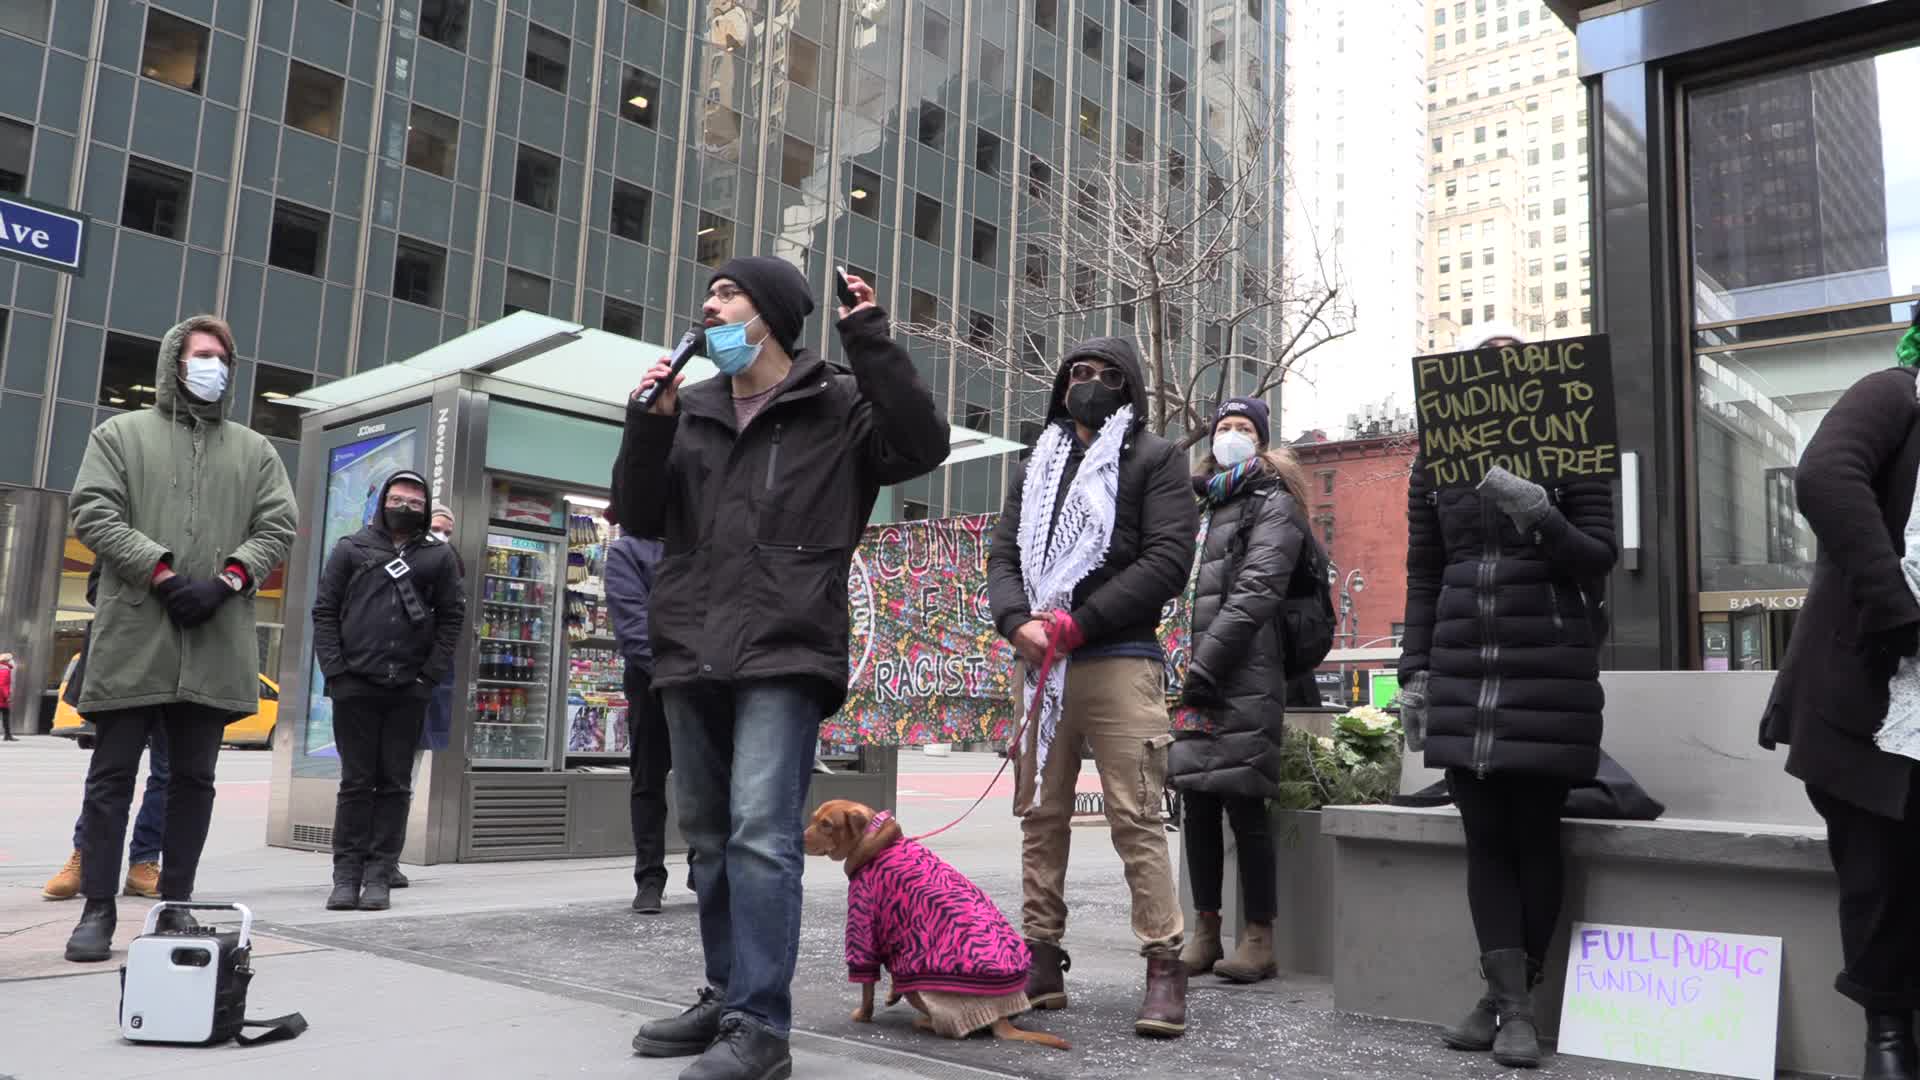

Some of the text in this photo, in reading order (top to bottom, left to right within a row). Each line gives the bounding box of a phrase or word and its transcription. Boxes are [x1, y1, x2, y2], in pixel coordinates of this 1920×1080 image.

[1418, 343, 1585, 390] FULL PUBLIC
[1418, 379, 1594, 424] FUNDING TO
[1425, 406, 1594, 457] MAKE CUNY
[1537, 444, 1615, 478] FREE
[876, 512, 989, 580] CUNY
[920, 582, 996, 630] FIG
[1729, 595, 1807, 610] BANK OF
[875, 653, 985, 703] RACIST
[1580, 929, 1768, 979] FULL PUBLIC
[1576, 964, 1703, 1006] FUNDING
